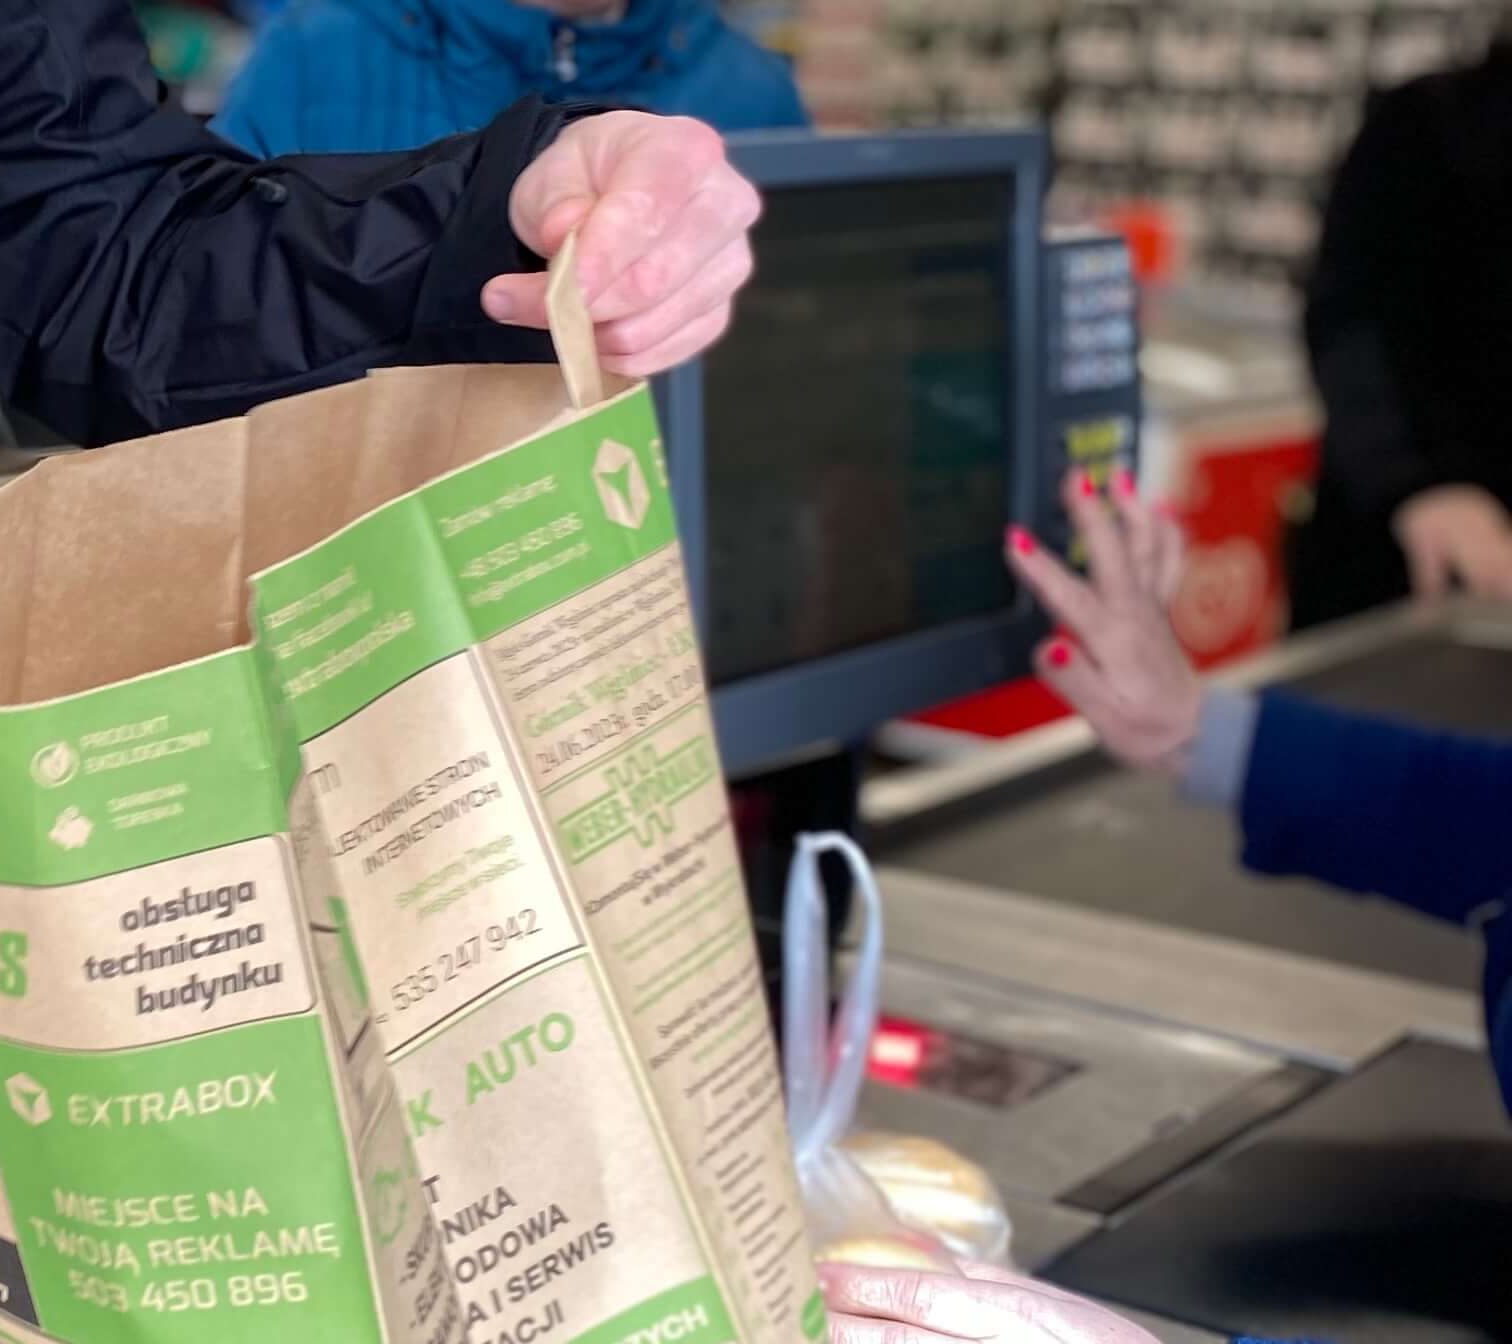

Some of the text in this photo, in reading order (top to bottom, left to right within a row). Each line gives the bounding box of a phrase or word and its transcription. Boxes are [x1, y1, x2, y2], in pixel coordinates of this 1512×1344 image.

[120, 879, 257, 932] obsługa
[486, 908, 543, 952] 942
[84, 920, 265, 983] techniczna
[136, 960, 285, 1016] budynku
[464, 1012, 575, 1105] AUTO
[68, 1070, 280, 1128] EXTRABOX
[53, 1187, 269, 1230] MIEJSCE NA
[29, 1216, 141, 1277] TWOJĄ
[149, 1222, 342, 1269] REKLAMĘ
[506, 1221, 616, 1302] SERWIS
[67, 1270, 308, 1313] 503 450 896
